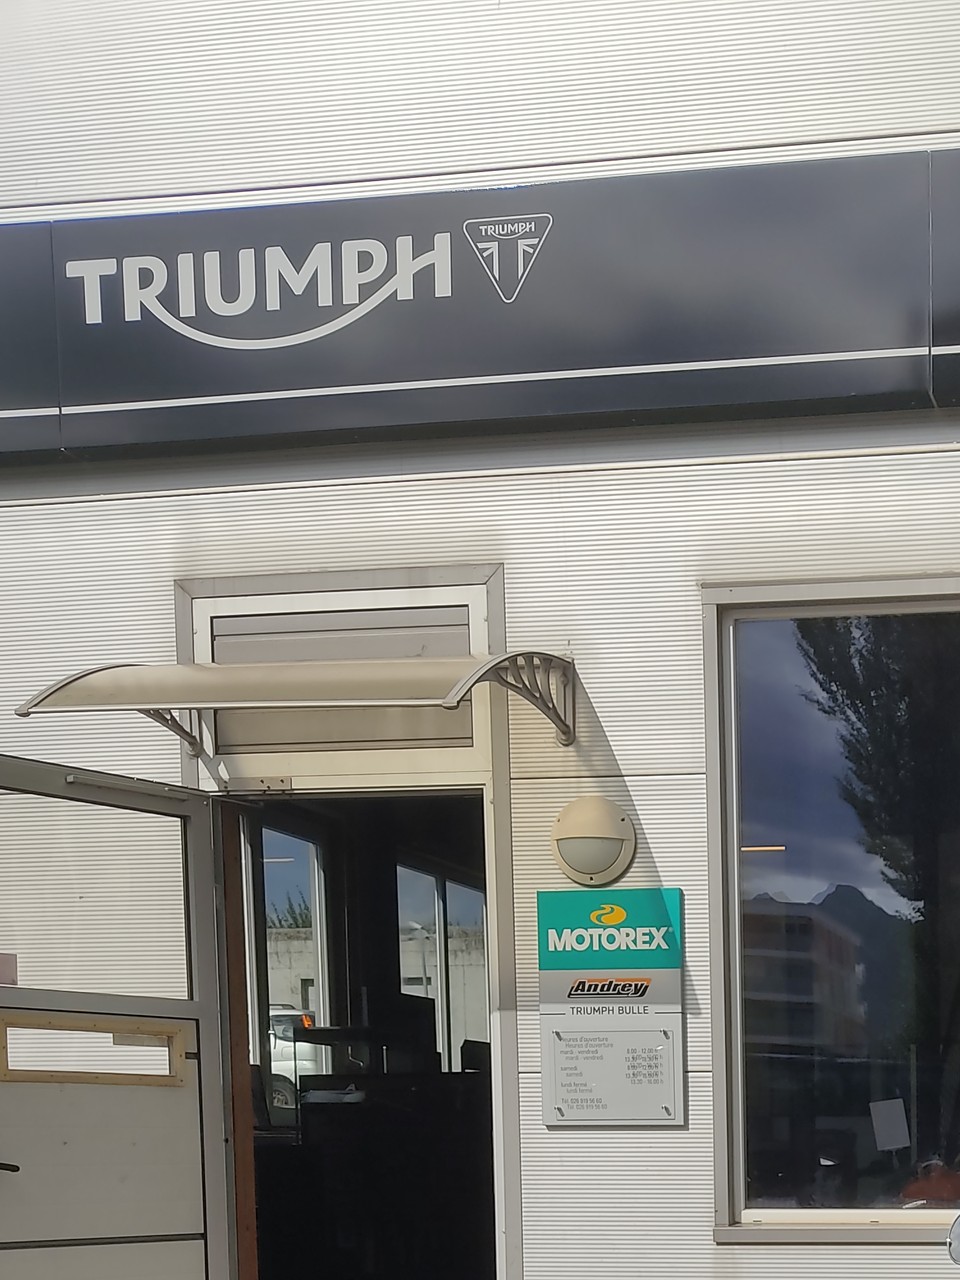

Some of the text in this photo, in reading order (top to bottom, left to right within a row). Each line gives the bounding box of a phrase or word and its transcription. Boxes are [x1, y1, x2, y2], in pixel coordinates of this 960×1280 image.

[479, 221, 535, 239] TRIUMPH
[65, 233, 452, 350] TRIUMPH
[548, 928, 669, 951] MOTOREX
[572, 979, 648, 998] Andrey
[569, 1005, 650, 1016] TRIUMPH BULLE
